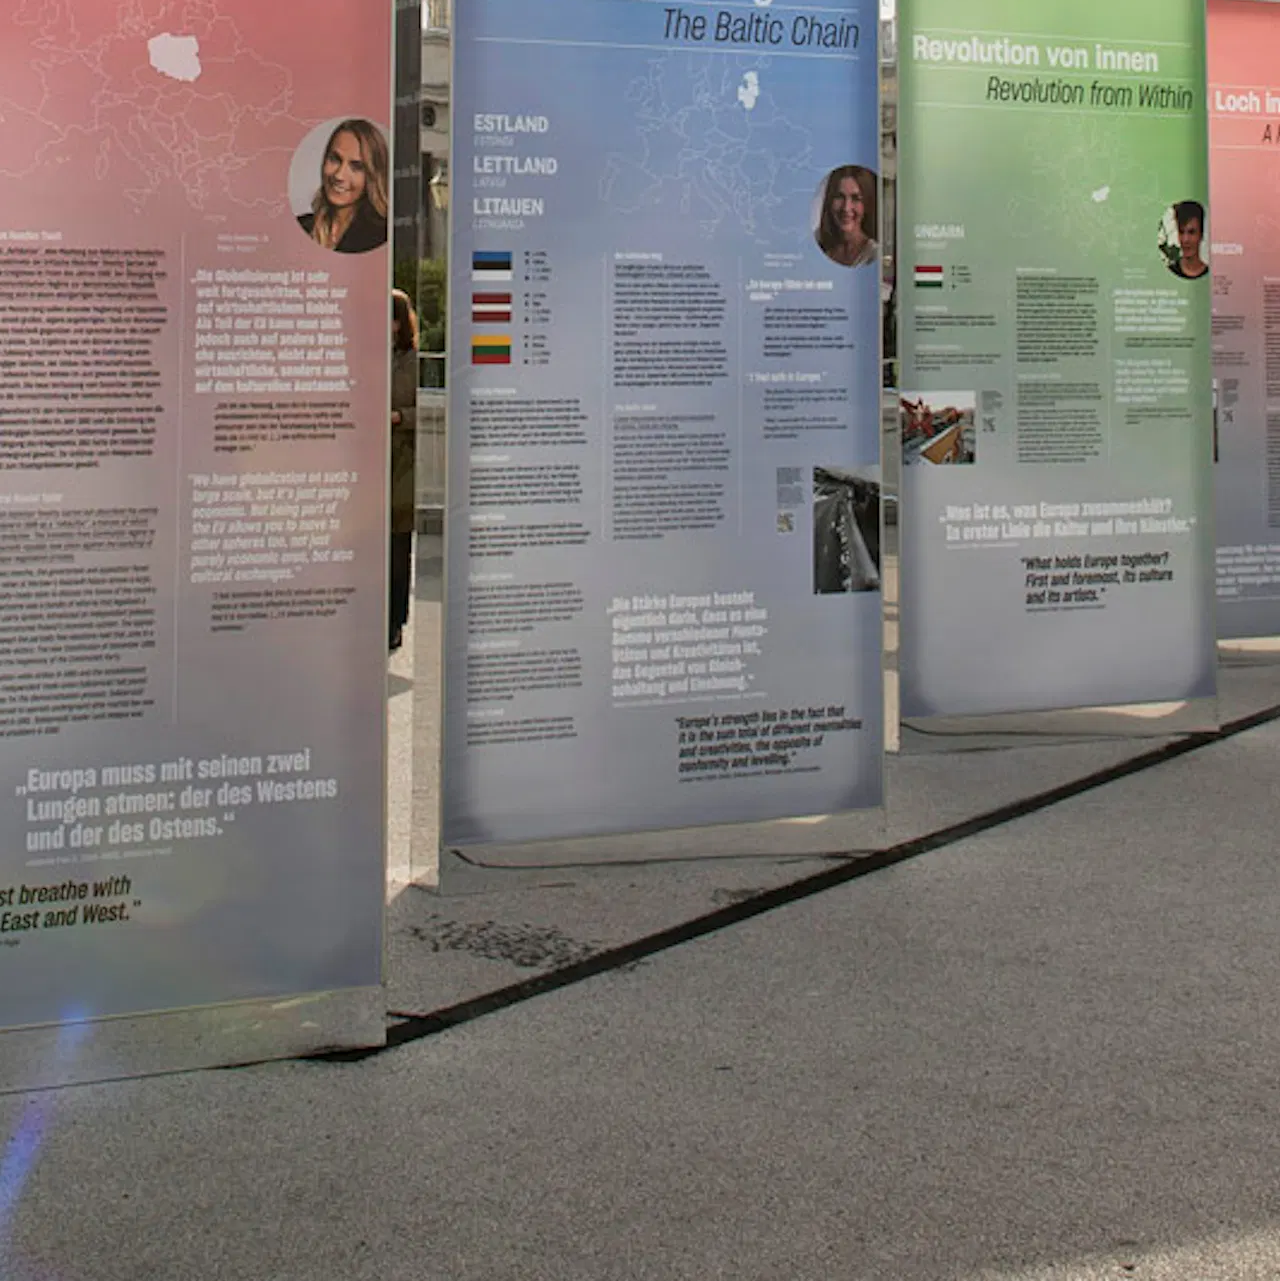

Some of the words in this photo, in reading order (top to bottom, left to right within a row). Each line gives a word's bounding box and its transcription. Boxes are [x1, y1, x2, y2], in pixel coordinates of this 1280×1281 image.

[663, 8, 705, 40] The
[714, 10, 783, 45] Baltic
[791, 17, 860, 49] Chain
[912, 35, 1039, 66] Revolution
[1046, 46, 1088, 68] von
[1096, 44, 1159, 72] innen
[986, 76, 1084, 105] Revolution
[1090, 81, 1132, 108] from
[1138, 84, 1193, 109] Within
[1215, 91, 1260, 112] Loch
[474, 113, 549, 133] ESTLAND
[1262, 124, 1272, 143] A
[473, 156, 558, 175] LETTLAND
[473, 198, 545, 216] LITAUEN
[1040, 501, 1080, 520] Europa
[1055, 555, 1081, 568] holds
[1084, 553, 1118, 569] Europe
[1121, 551, 1169, 568] together?
[1024, 574, 1048, 587] First
[1051, 573, 1070, 586] and
[1123, 570, 1136, 583] its
[1139, 570, 1174, 583] culture
[1026, 591, 1046, 605] and
[1048, 590, 1061, 603] its
[650, 644, 670, 660] und
[668, 676, 689, 693] und
[721, 711, 760, 726] strength
[790, 708, 805, 720] the
[808, 706, 825, 718] fact
[827, 705, 845, 717] that
[699, 729, 714, 742] the
[760, 725, 770, 737] of
[679, 745, 697, 758] and
[755, 739, 770, 751] the
[813, 735, 823, 746] of
[15, 767, 96, 796] „Europa
[101, 763, 156, 787] muss
[161, 756, 193, 782] mit
[197, 754, 262, 780] seinen
[266, 747, 311, 773] zwei
[732, 755, 748, 768] and
[26, 795, 100, 824] Lungen
[104, 790, 175, 816] atmen:
[180, 785, 211, 809] der
[217, 781, 252, 806] des
[257, 776, 338, 803] Westens
[26, 825, 65, 852] und
[70, 822, 103, 848] der
[108, 819, 144, 844] des
[19, 880, 88, 906] breathe
[92, 874, 133, 898] with
[0, 911, 39, 933] East
[44, 904, 78, 928] and
